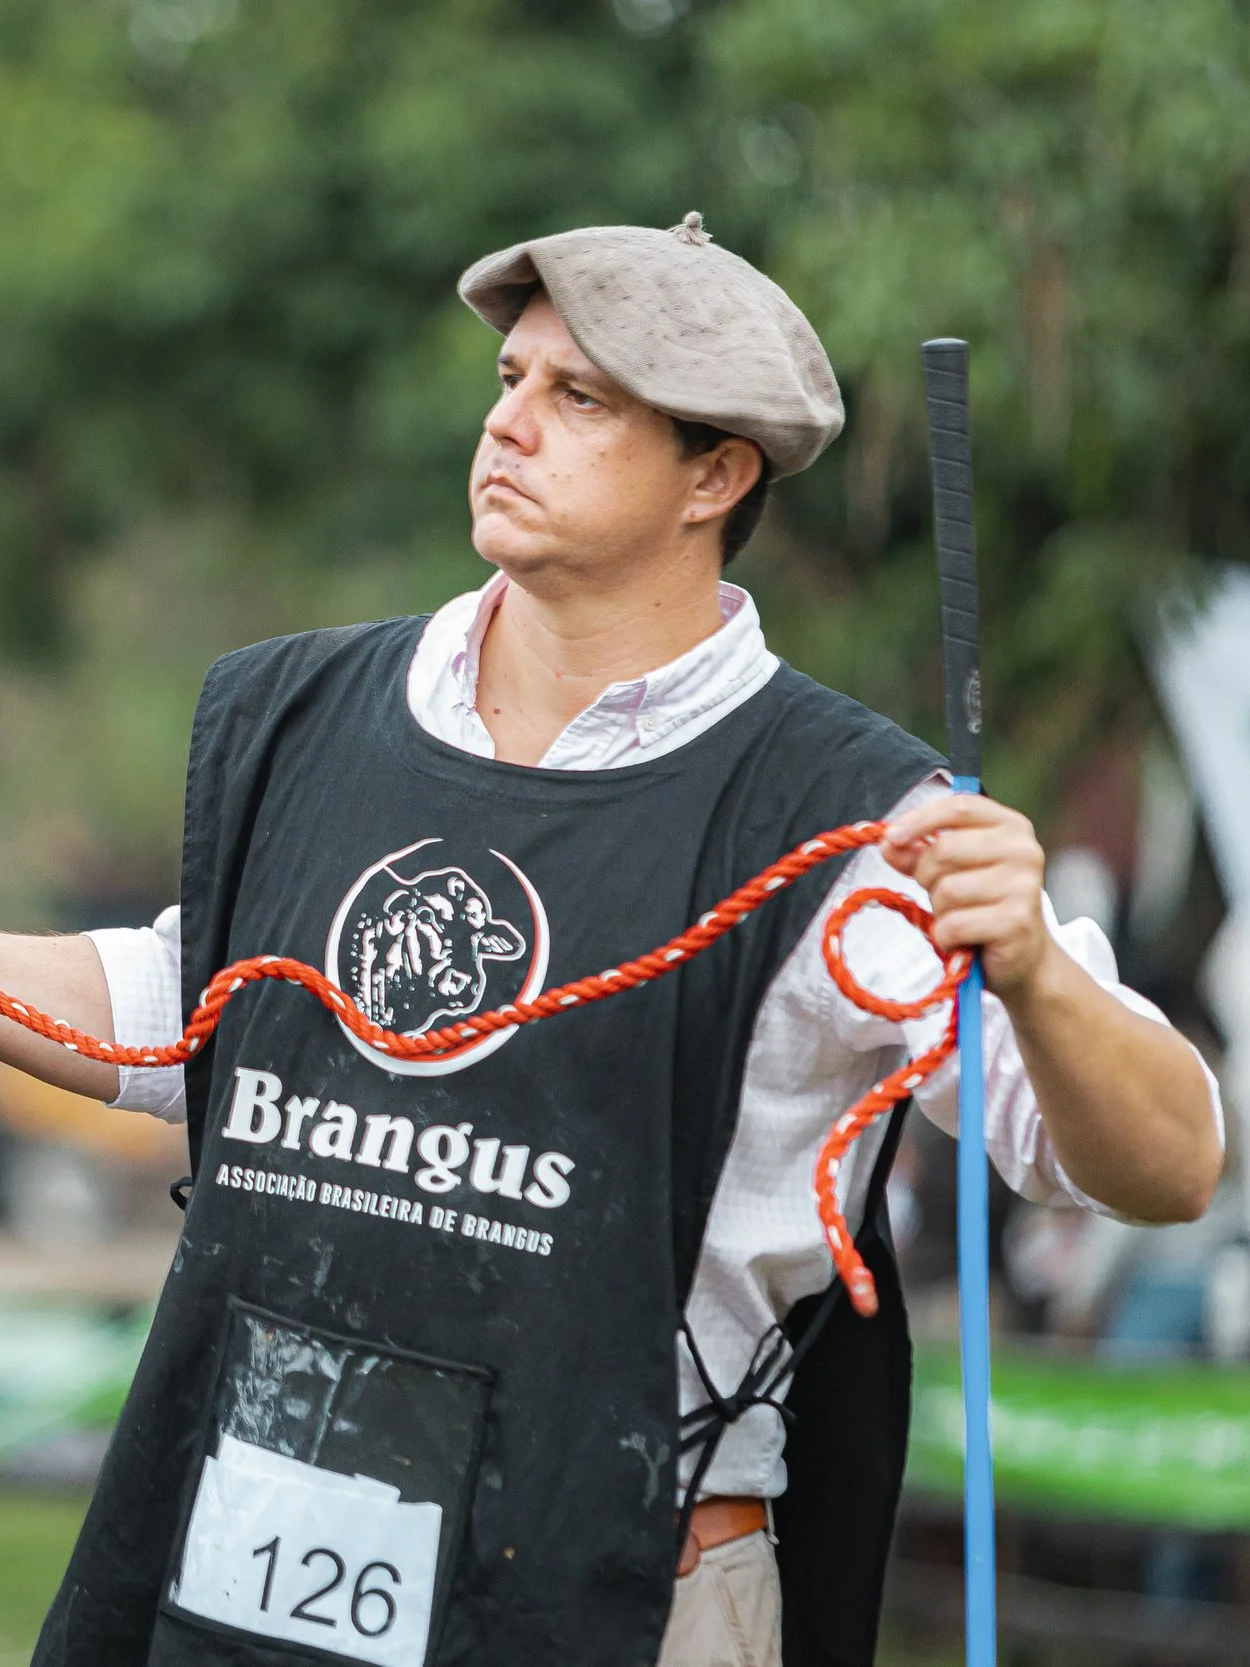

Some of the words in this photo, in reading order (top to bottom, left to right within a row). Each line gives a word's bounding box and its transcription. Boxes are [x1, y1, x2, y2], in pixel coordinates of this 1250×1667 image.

[222, 1067, 576, 1209] Brangus
[215, 1163, 318, 1203] ASSOCIAÇÃO
[319, 1182, 423, 1226] BRASILEIRA
[429, 1206, 457, 1233] DE
[461, 1214, 554, 1257] BRANGUS
[252, 1536, 403, 1637] 126
